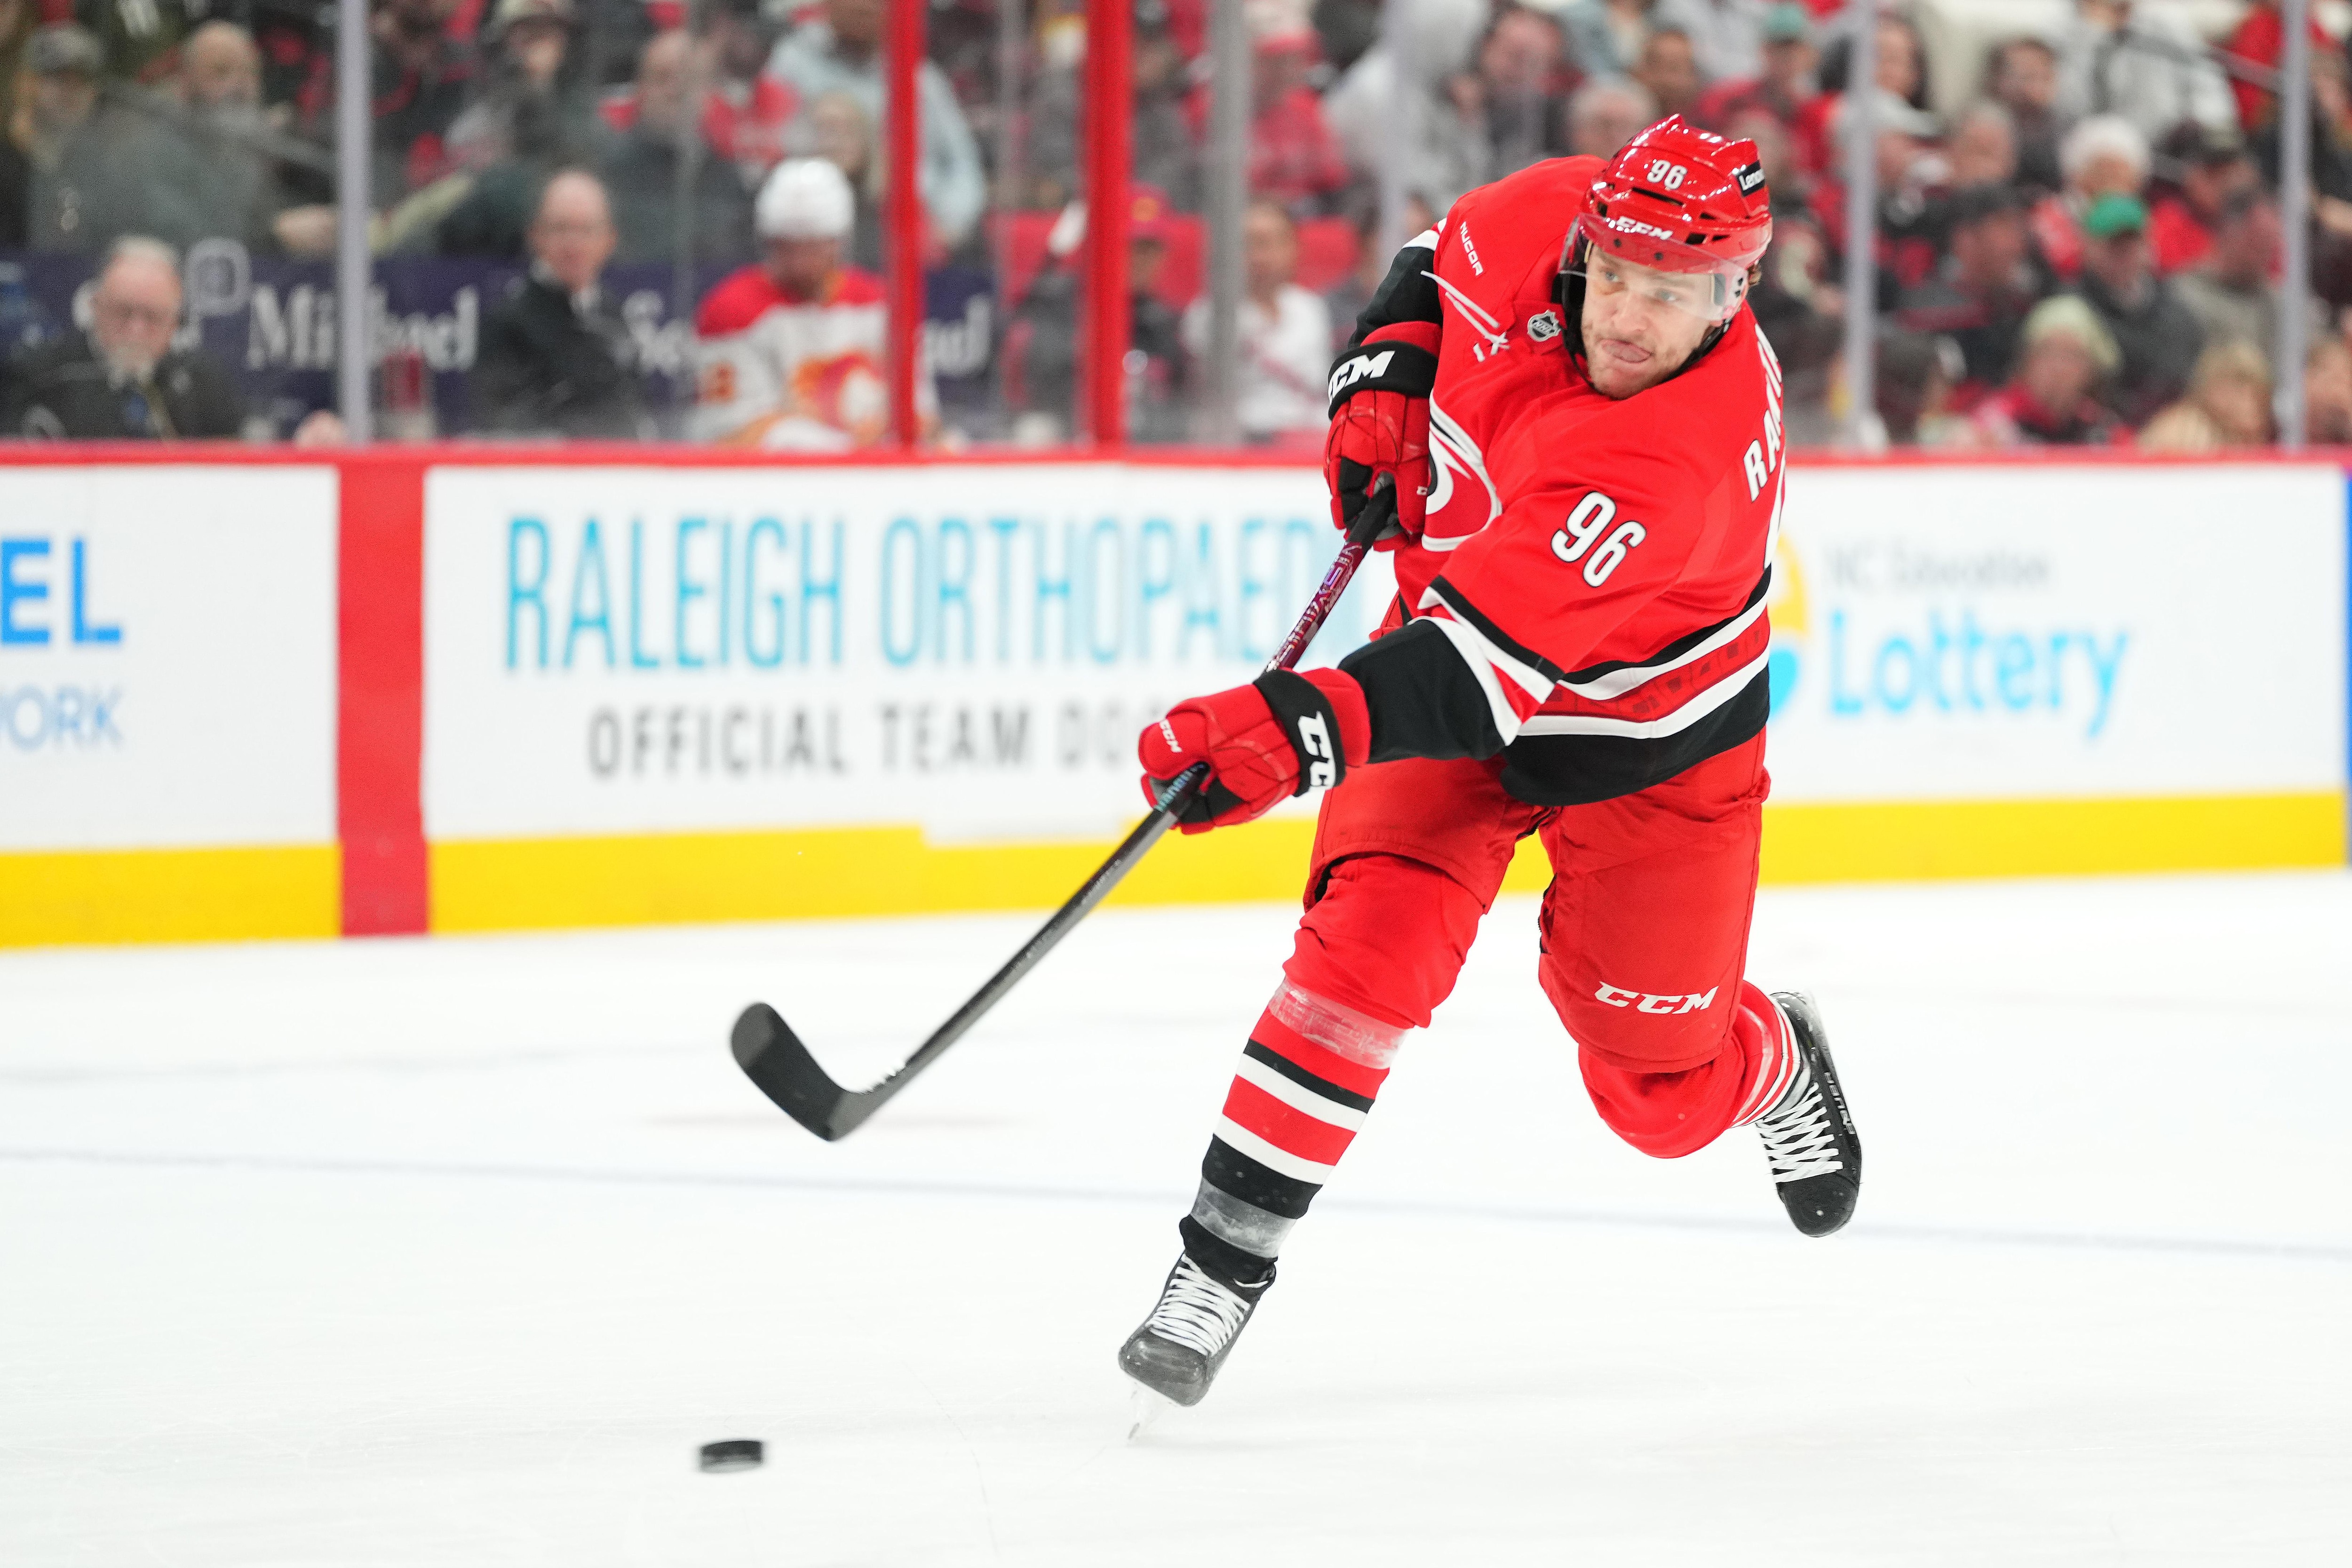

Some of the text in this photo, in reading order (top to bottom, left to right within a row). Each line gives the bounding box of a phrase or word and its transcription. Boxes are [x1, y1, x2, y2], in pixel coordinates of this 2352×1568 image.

[1646, 159, 1688, 190] 96
[1459, 221, 1483, 277] NUCOR
[1615, 215, 1674, 240] CCM
[1532, 320, 1552, 335] NHL
[1551, 491, 1647, 588] 96
[0, 538, 123, 645] EL
[507, 517, 846, 670] RALEIGH
[1828, 609, 2131, 740] Lottery
[0, 684, 123, 751] ORK
[588, 705, 850, 779] OFFICIAL
[881, 700, 1030, 774] TEAM
[1159, 719, 1183, 753] CCM
[1594, 981, 1719, 1014] CCM
